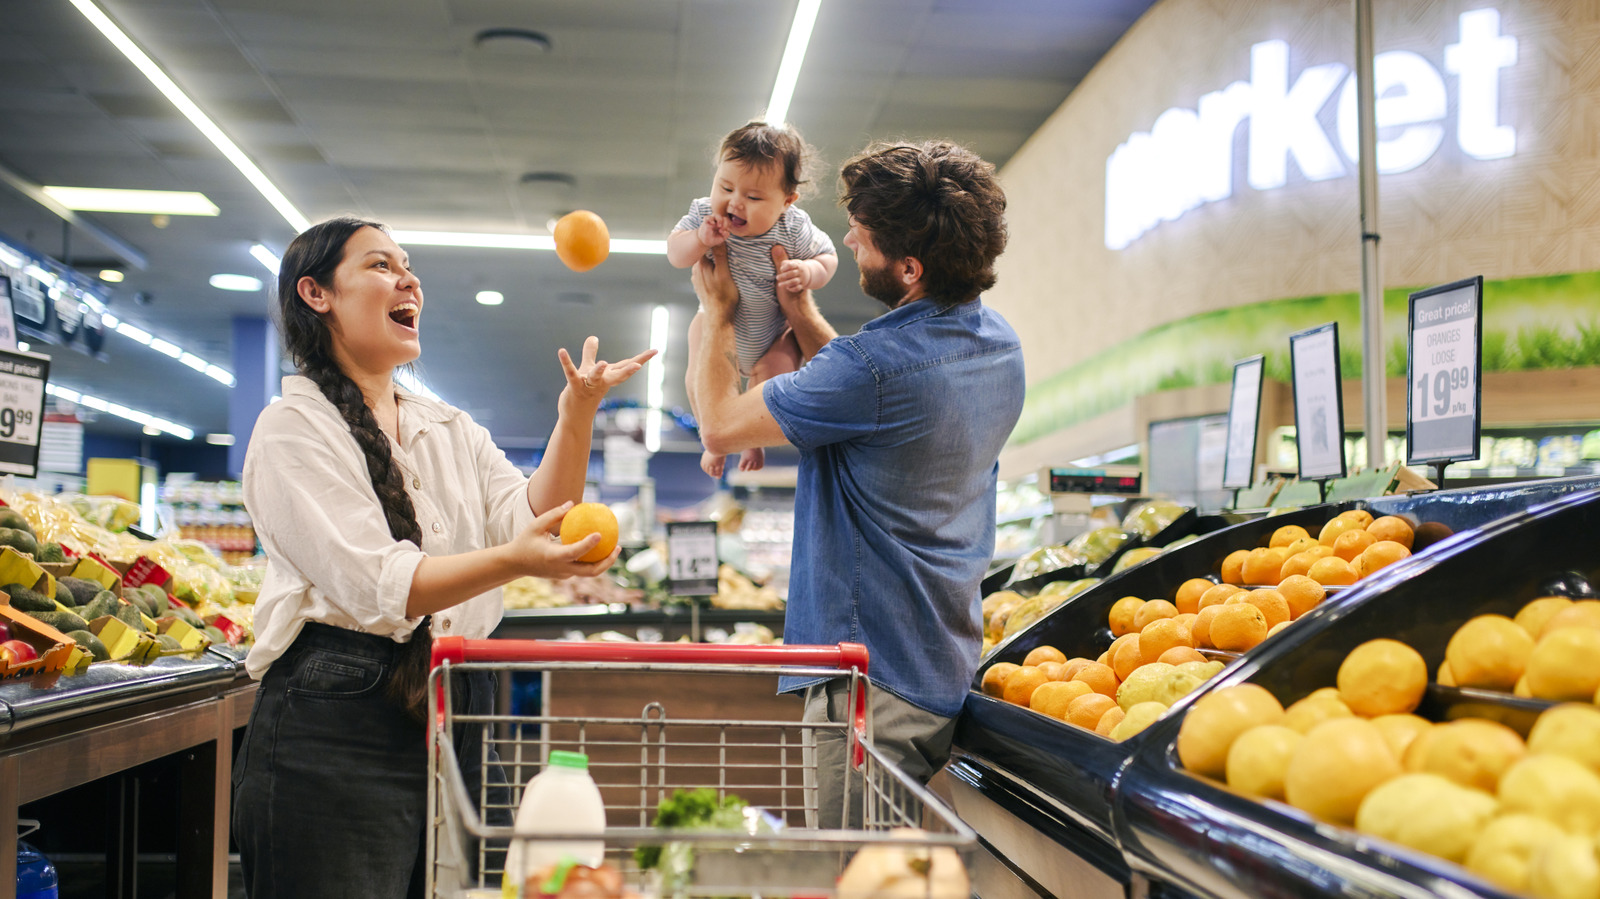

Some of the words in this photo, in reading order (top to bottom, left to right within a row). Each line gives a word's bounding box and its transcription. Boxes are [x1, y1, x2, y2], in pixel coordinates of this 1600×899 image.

[1418, 306, 1443, 324] Great
[1444, 299, 1471, 320] price!
[1426, 328, 1461, 348] ORANGES
[1431, 349, 1456, 366] LOOSE
[1452, 402, 1467, 414] p/kg
